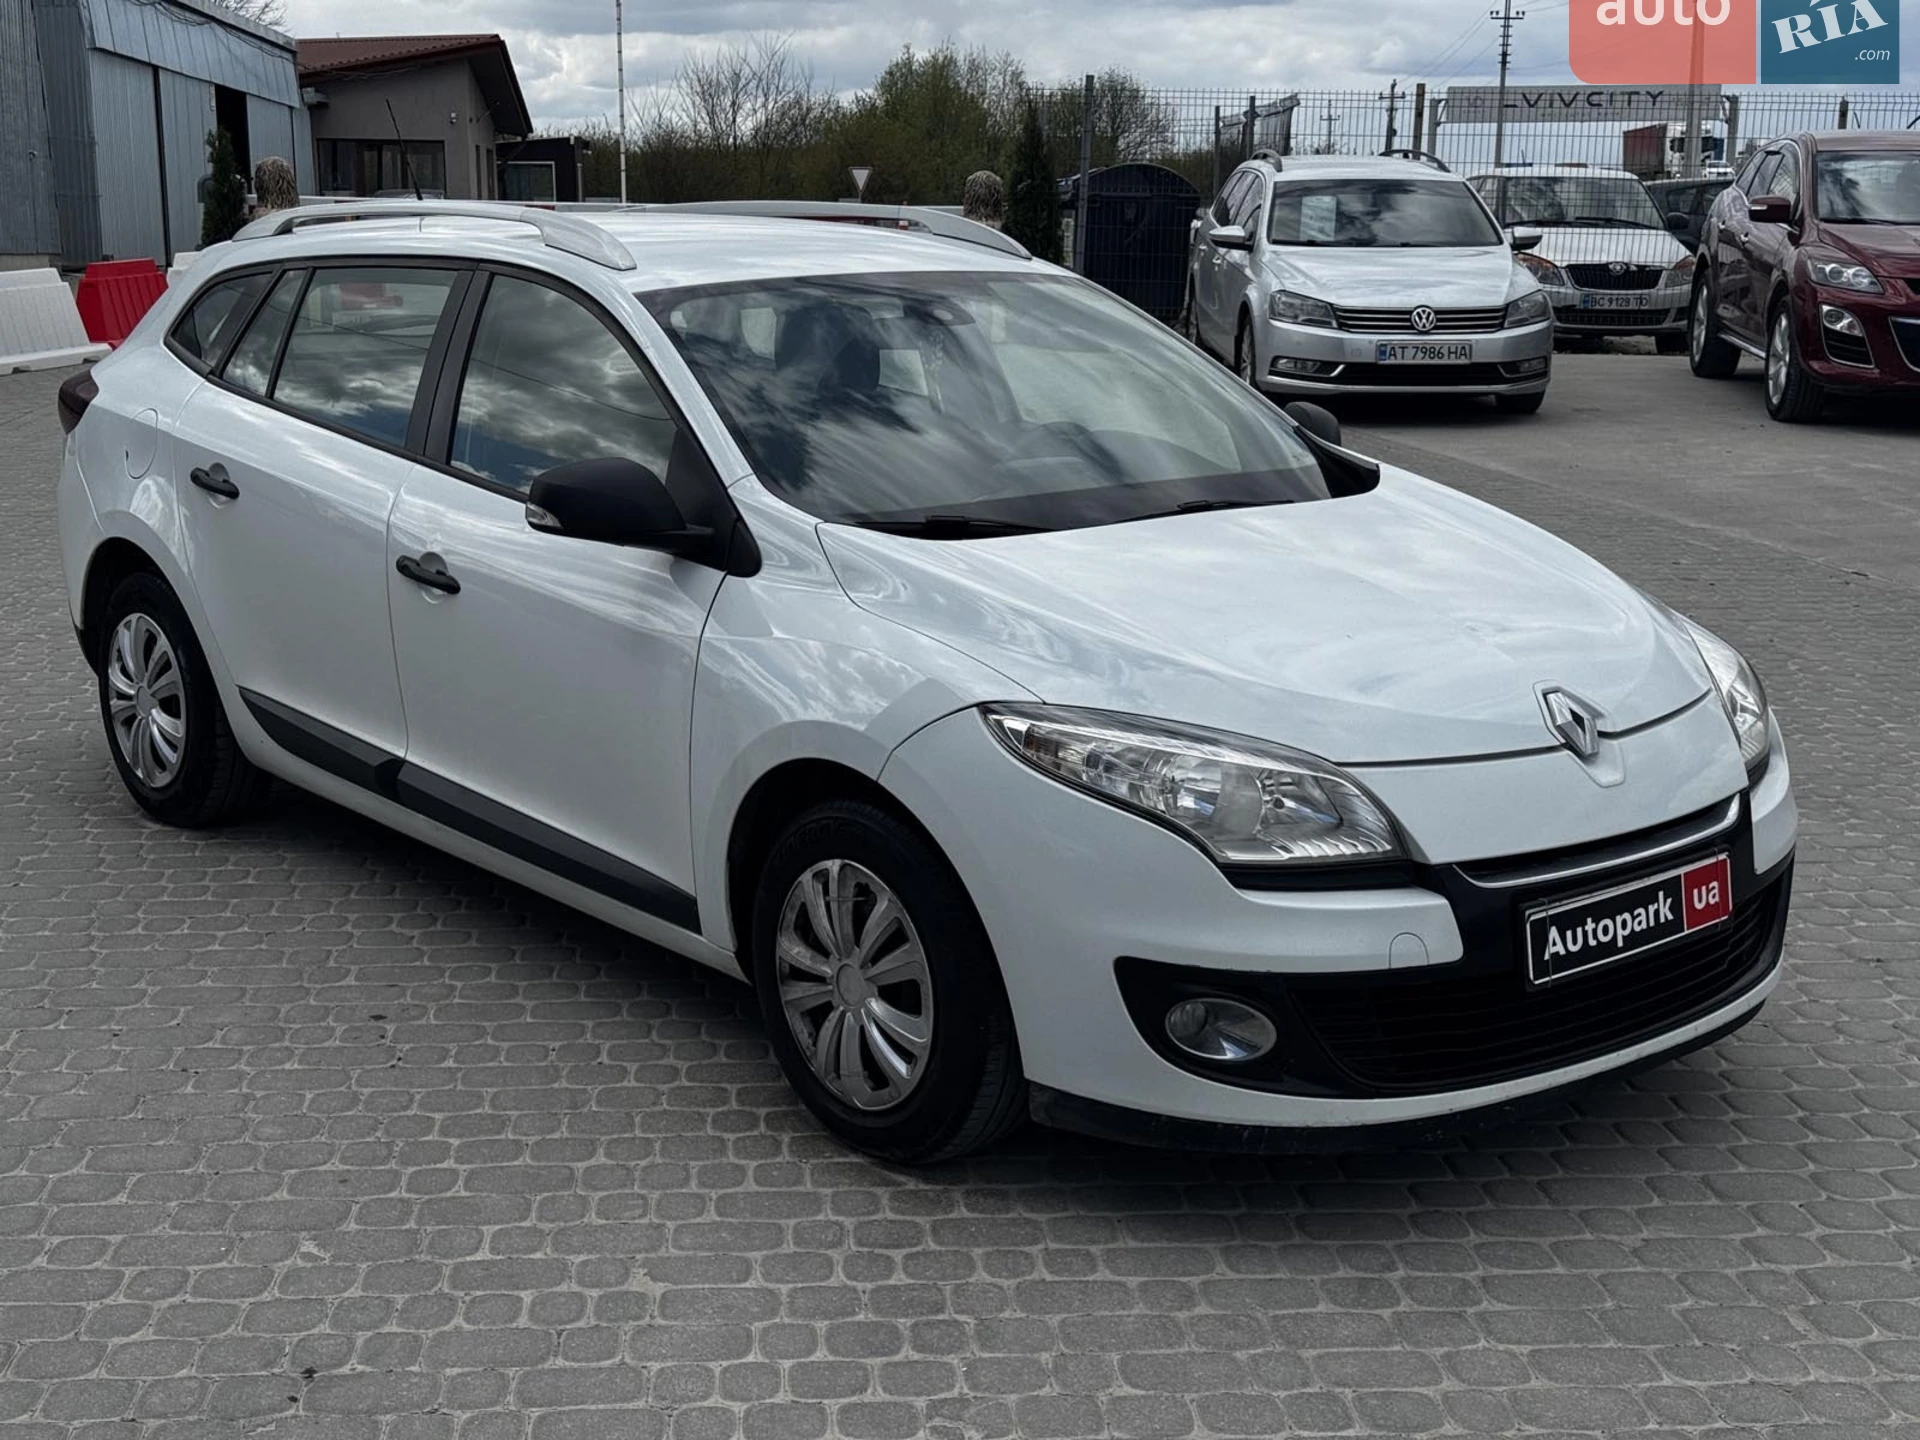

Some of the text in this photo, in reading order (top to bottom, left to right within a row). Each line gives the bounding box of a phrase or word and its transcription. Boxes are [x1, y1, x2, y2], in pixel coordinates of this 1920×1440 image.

[1590, 296, 1605, 308] BC
[1387, 345, 1469, 361] AT 7986 HA
[1543, 880, 1720, 961] Autopark ua
